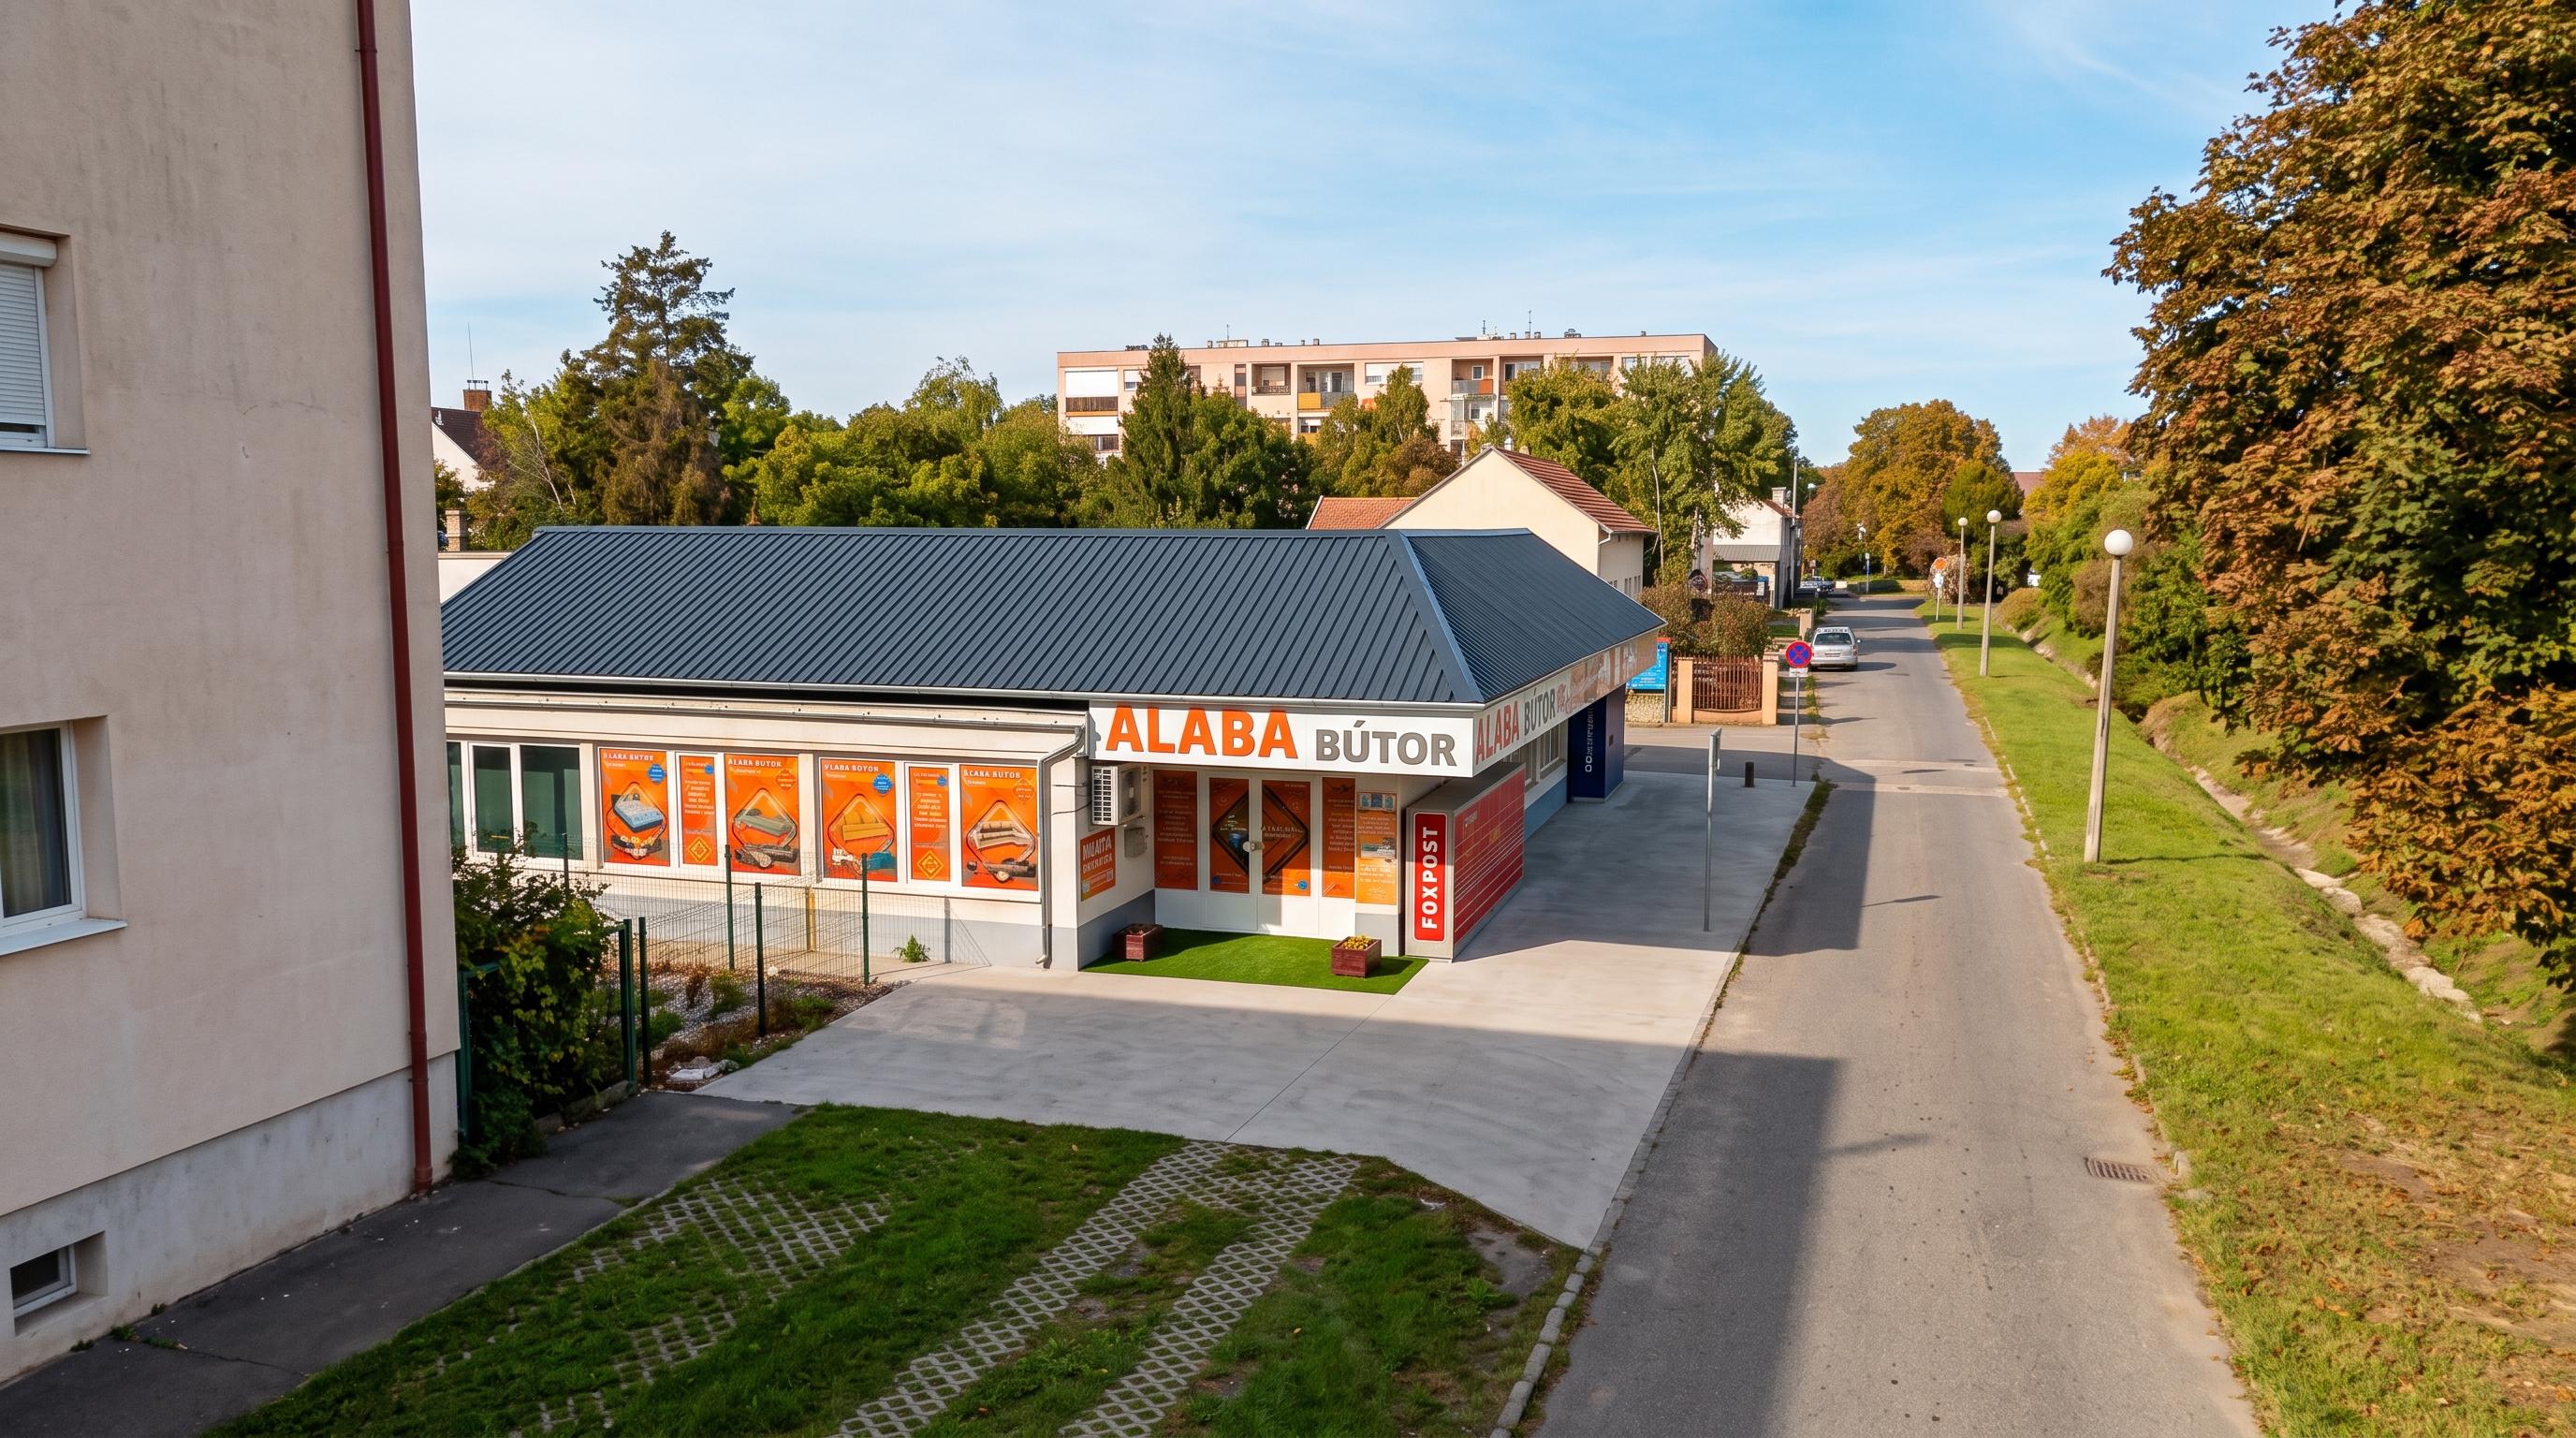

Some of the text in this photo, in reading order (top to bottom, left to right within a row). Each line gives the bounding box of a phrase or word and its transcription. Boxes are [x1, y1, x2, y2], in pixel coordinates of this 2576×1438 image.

[1105, 704, 1457, 767] ALABA BÚTOR
[1474, 700, 1520, 766] ALABA
[1524, 687, 1556, 736] BÚTOR
[1421, 827, 1439, 930] FOXPOST
